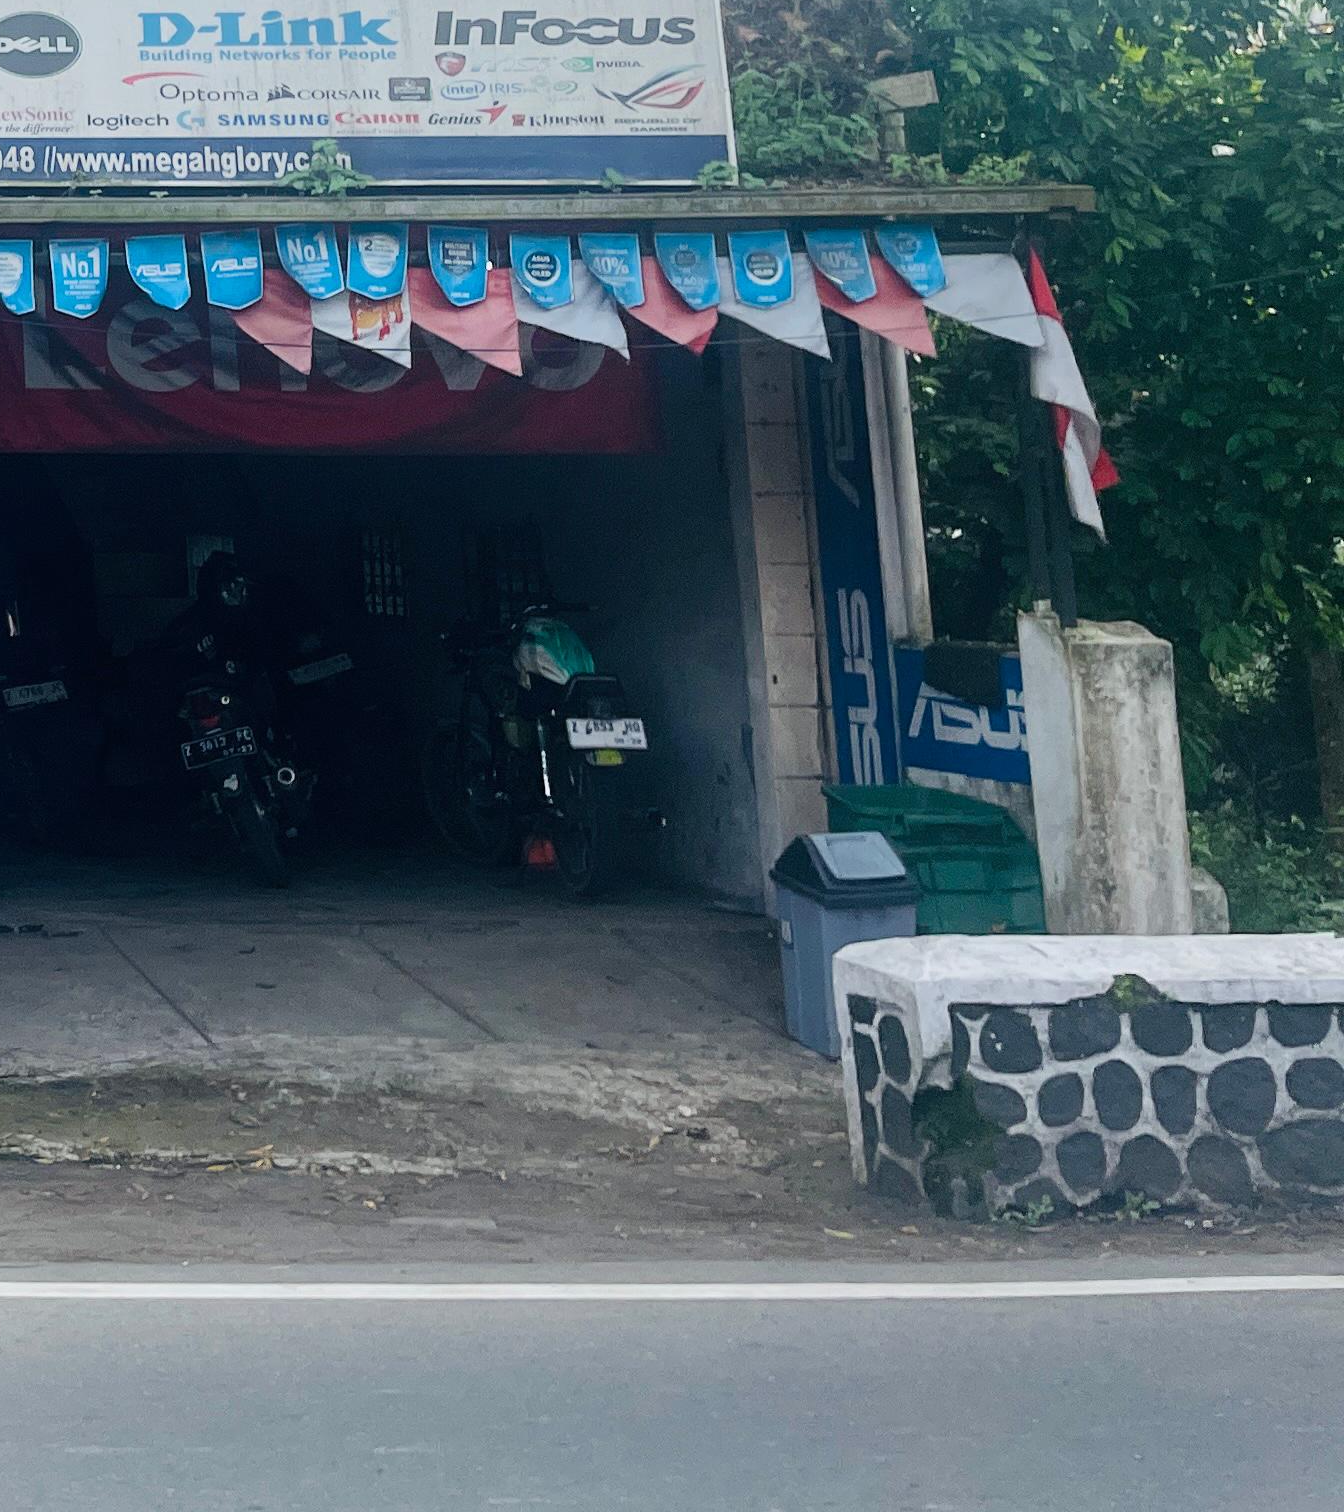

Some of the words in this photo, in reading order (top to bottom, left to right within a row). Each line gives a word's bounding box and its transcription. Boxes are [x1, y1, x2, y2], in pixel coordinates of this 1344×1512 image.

[138, 10, 398, 46] D-Link
[434, 10, 696, 47] InFocus
[140, 49, 212, 64] Building
[220, 49, 300, 61] Networks
[307, 49, 330, 61] for
[339, 49, 397, 64] People
[160, 84, 259, 102] Optoma
[297, 89, 382, 101] CORSAIR
[87, 114, 169, 130] logitech
[218, 114, 329, 126] SAMSUNG
[335, 111, 420, 125] Canon
[429, 113, 482, 126] Genius
[529, 114, 605, 127] Kingston
[4, 123, 20, 133] the
[287, 231, 328, 262] No.1
[364, 239, 372, 251] 2
[63, 248, 100, 278] No.1
[137, 264, 181, 276] ASUS
[211, 257, 258, 272] ASUS
[594, 255, 629, 275] 40%
[836, 588, 884, 786] SUS
